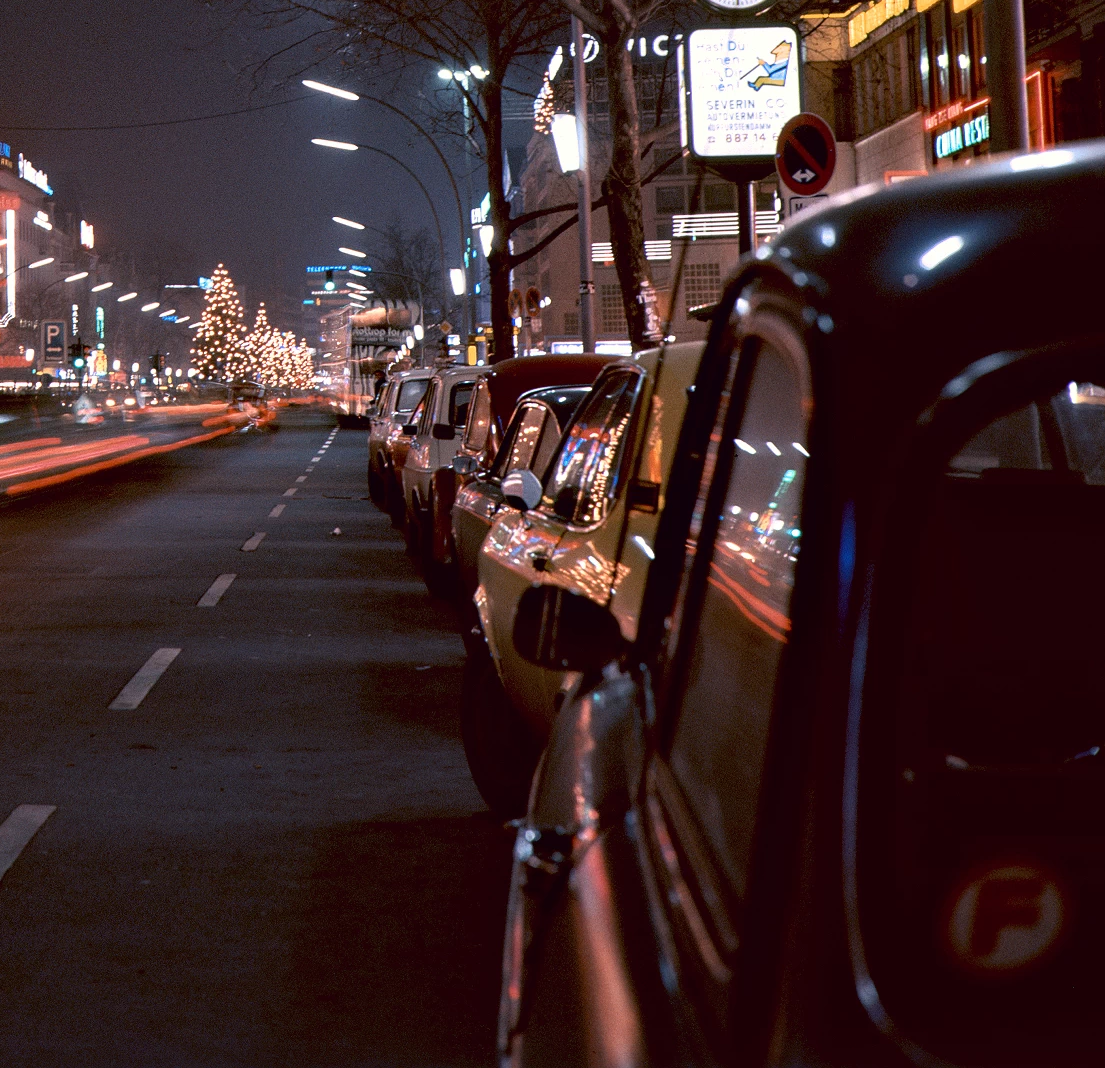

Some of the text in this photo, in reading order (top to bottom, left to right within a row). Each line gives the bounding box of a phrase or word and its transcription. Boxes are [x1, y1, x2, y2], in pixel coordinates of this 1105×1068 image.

[728, 40, 745, 51] Du
[706, 99, 755, 111] SEVERIN
[725, 133, 749, 143] 887
[754, 133, 766, 142] 14
[47, 325, 60, 345] P
